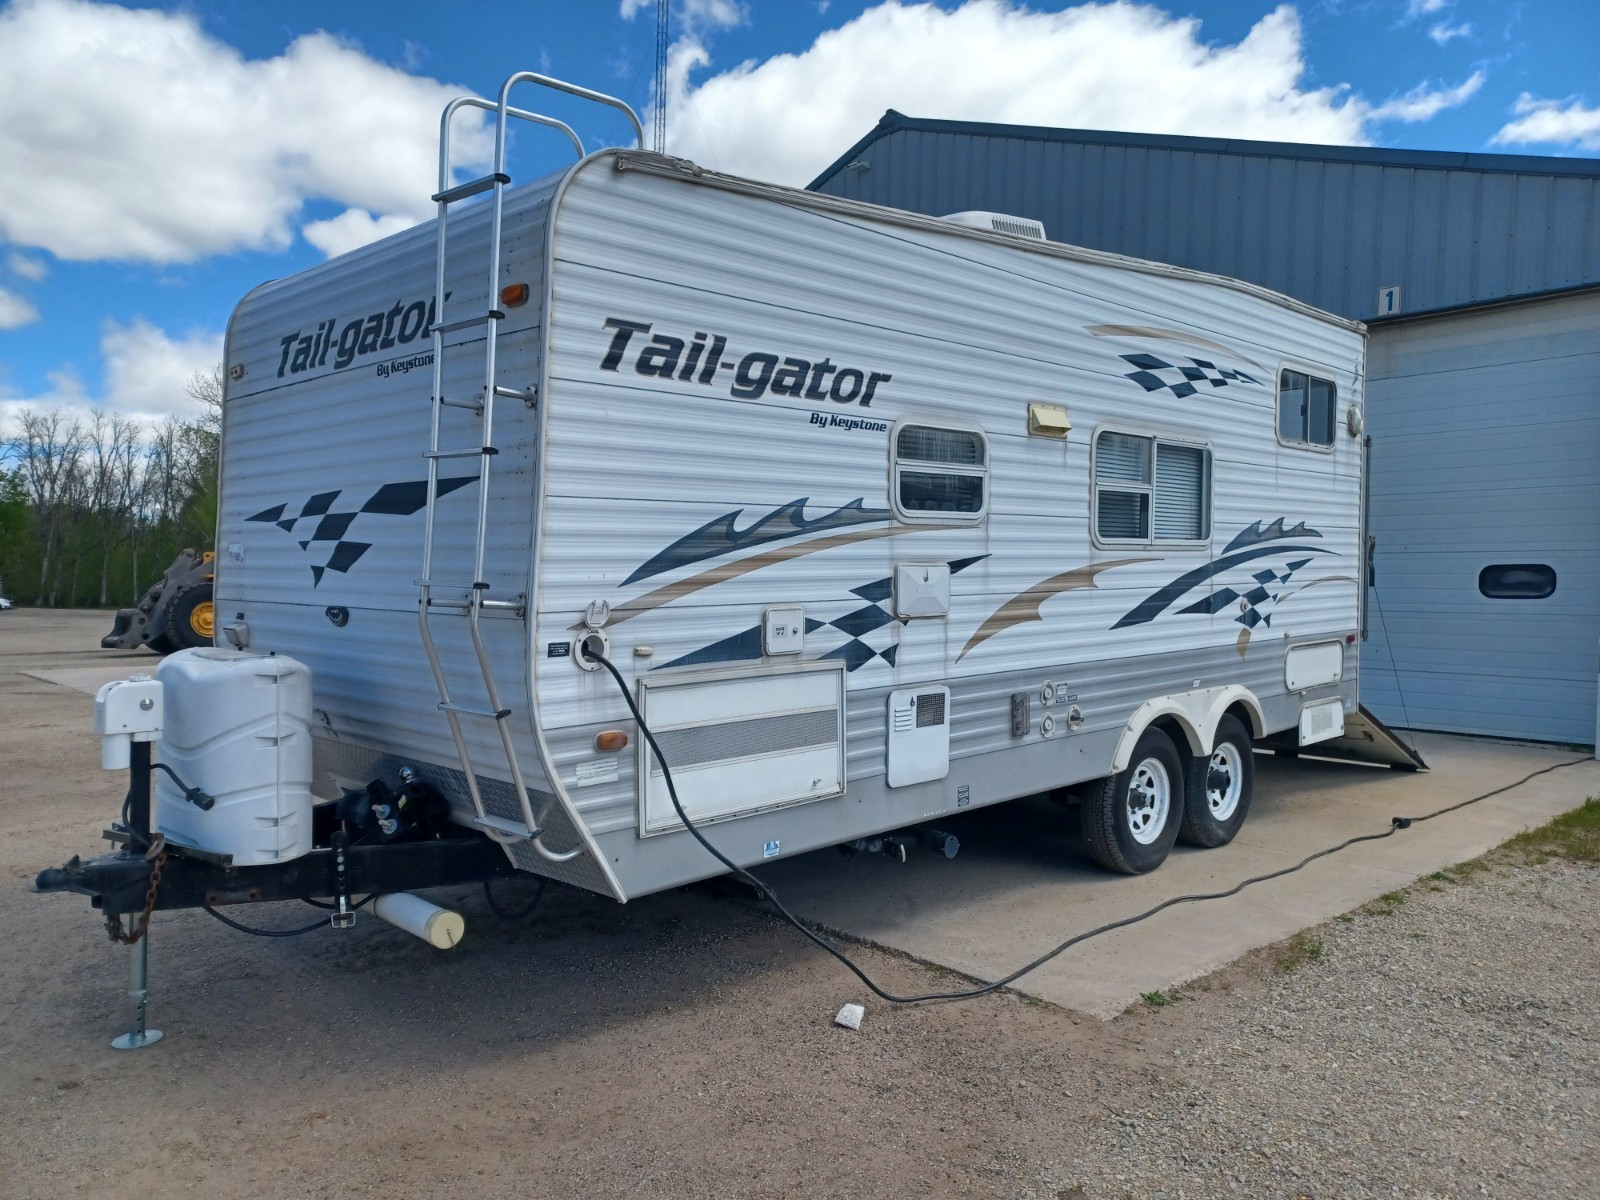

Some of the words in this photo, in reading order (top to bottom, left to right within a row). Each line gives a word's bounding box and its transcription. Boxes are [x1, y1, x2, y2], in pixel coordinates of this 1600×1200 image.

[1386, 290, 1393, 311] 1
[376, 364, 390, 378] By
[600, 316, 892, 408] Tail-gator
[809, 412, 828, 428] By
[829, 415, 888, 432] Keystone
